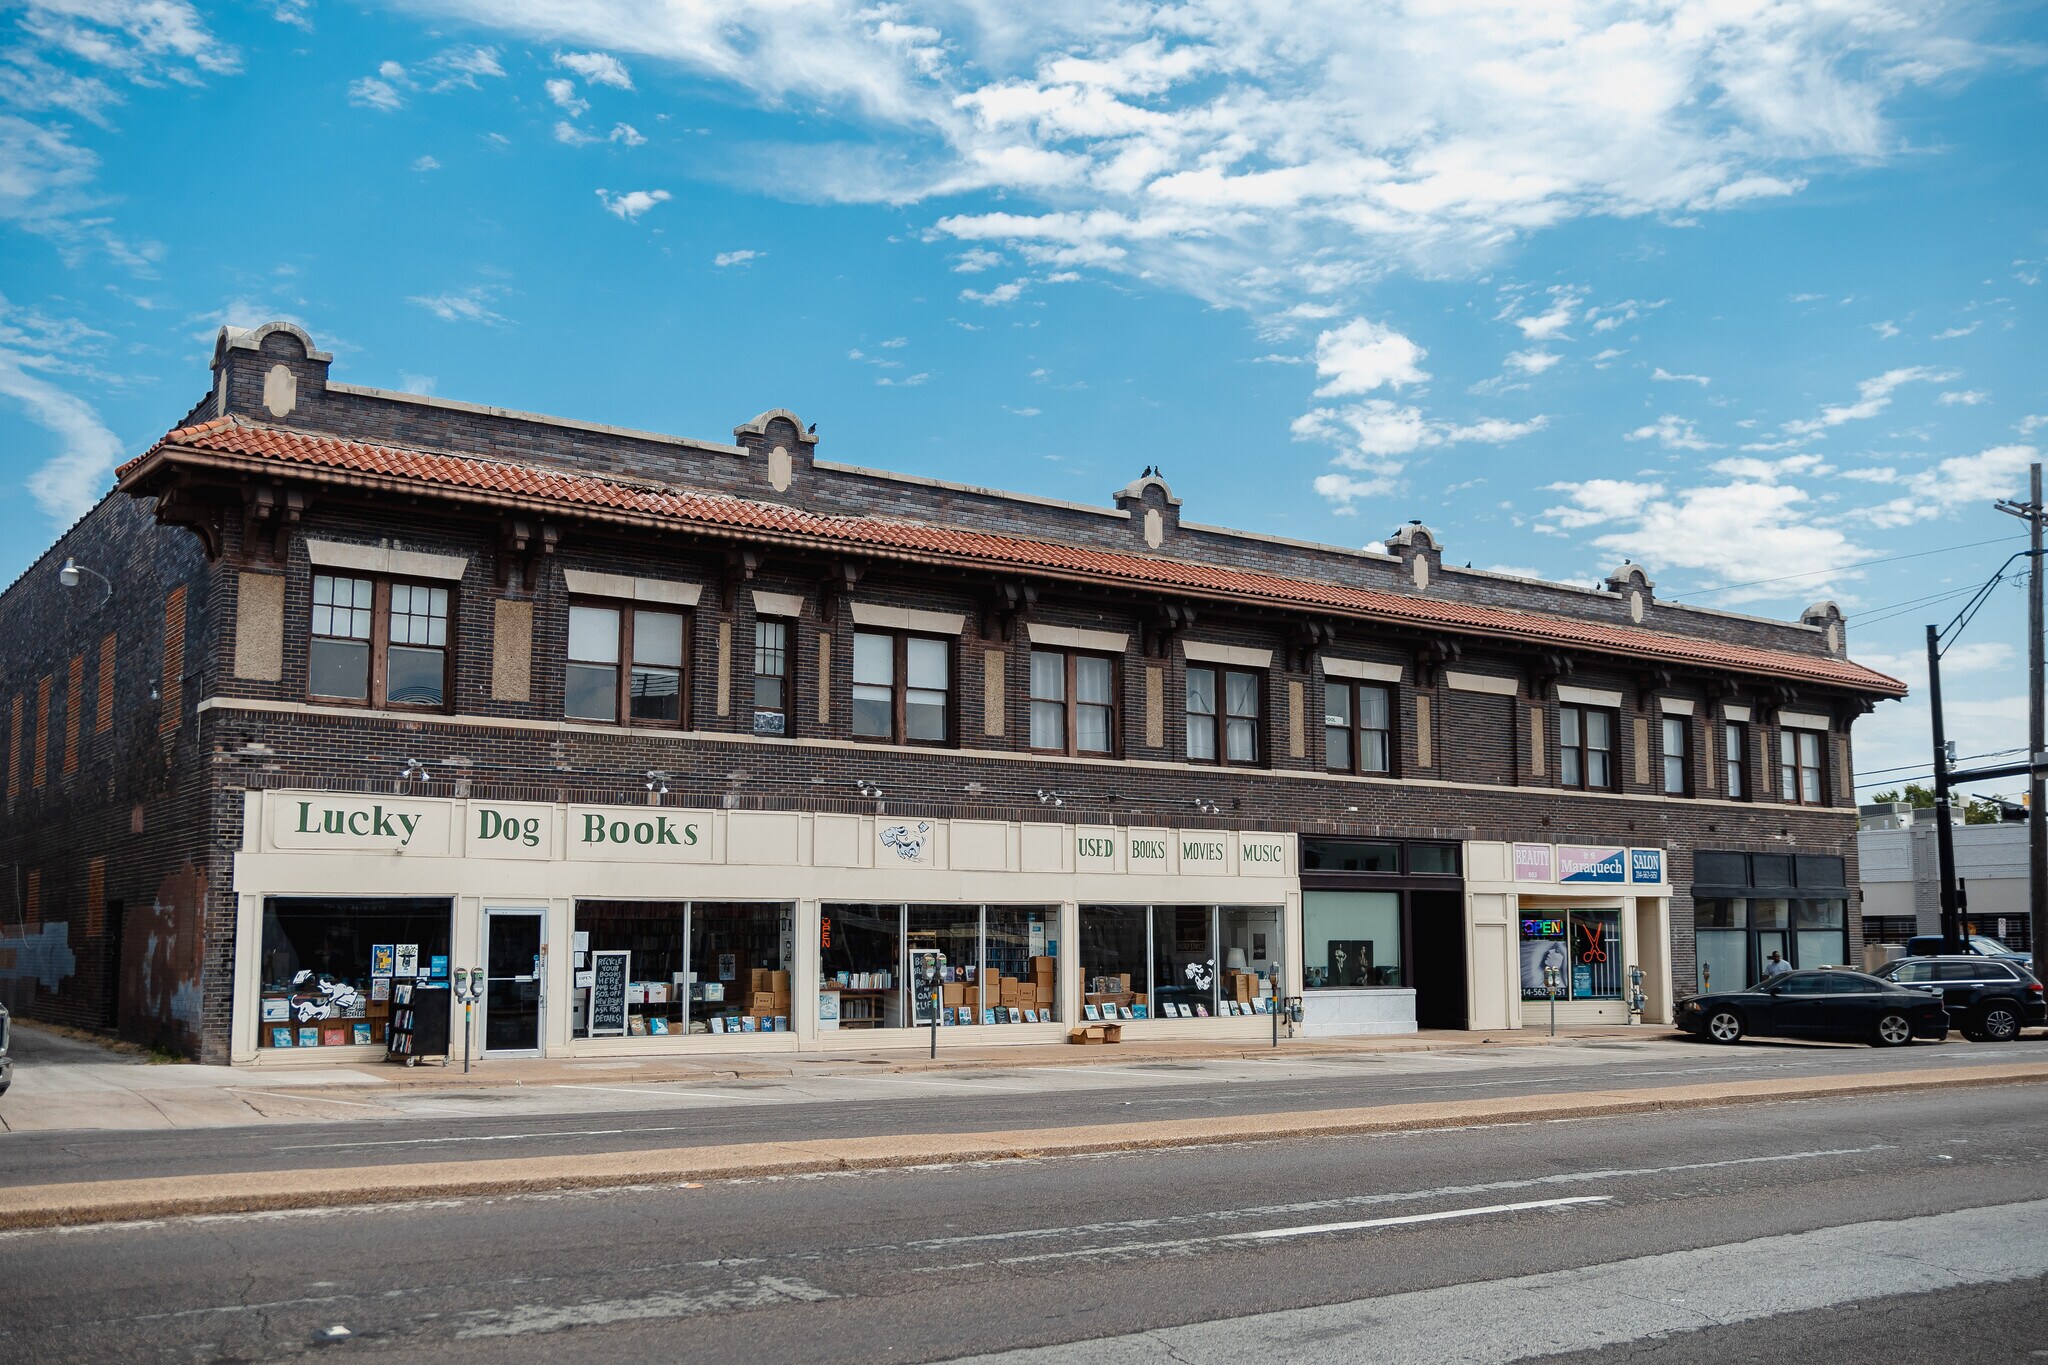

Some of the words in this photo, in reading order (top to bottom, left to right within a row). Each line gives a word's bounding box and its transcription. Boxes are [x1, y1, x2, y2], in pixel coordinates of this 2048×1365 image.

[294, 801, 421, 845] Lucky
[478, 809, 540, 847] Dog
[581, 814, 698, 847] Books
[1078, 838, 1113, 857] USED
[1132, 840, 1165, 859] BOOKS
[1183, 842, 1223, 861] MOVIES
[1243, 844, 1282, 862] MUSIC
[1515, 849, 1549, 866] BEAUTY
[1561, 859, 1622, 877] Maraquech
[1634, 854, 1658, 870] SALON
[822, 918, 830, 948] OPEN
[1524, 921, 1561, 933] OPEN
[598, 957, 623, 966] RECYCLE
[1521, 988, 1566, 996] 14-562-151
[916, 1001, 932, 1010] CLIF
[595, 1014, 622, 1023] DETAILS!
